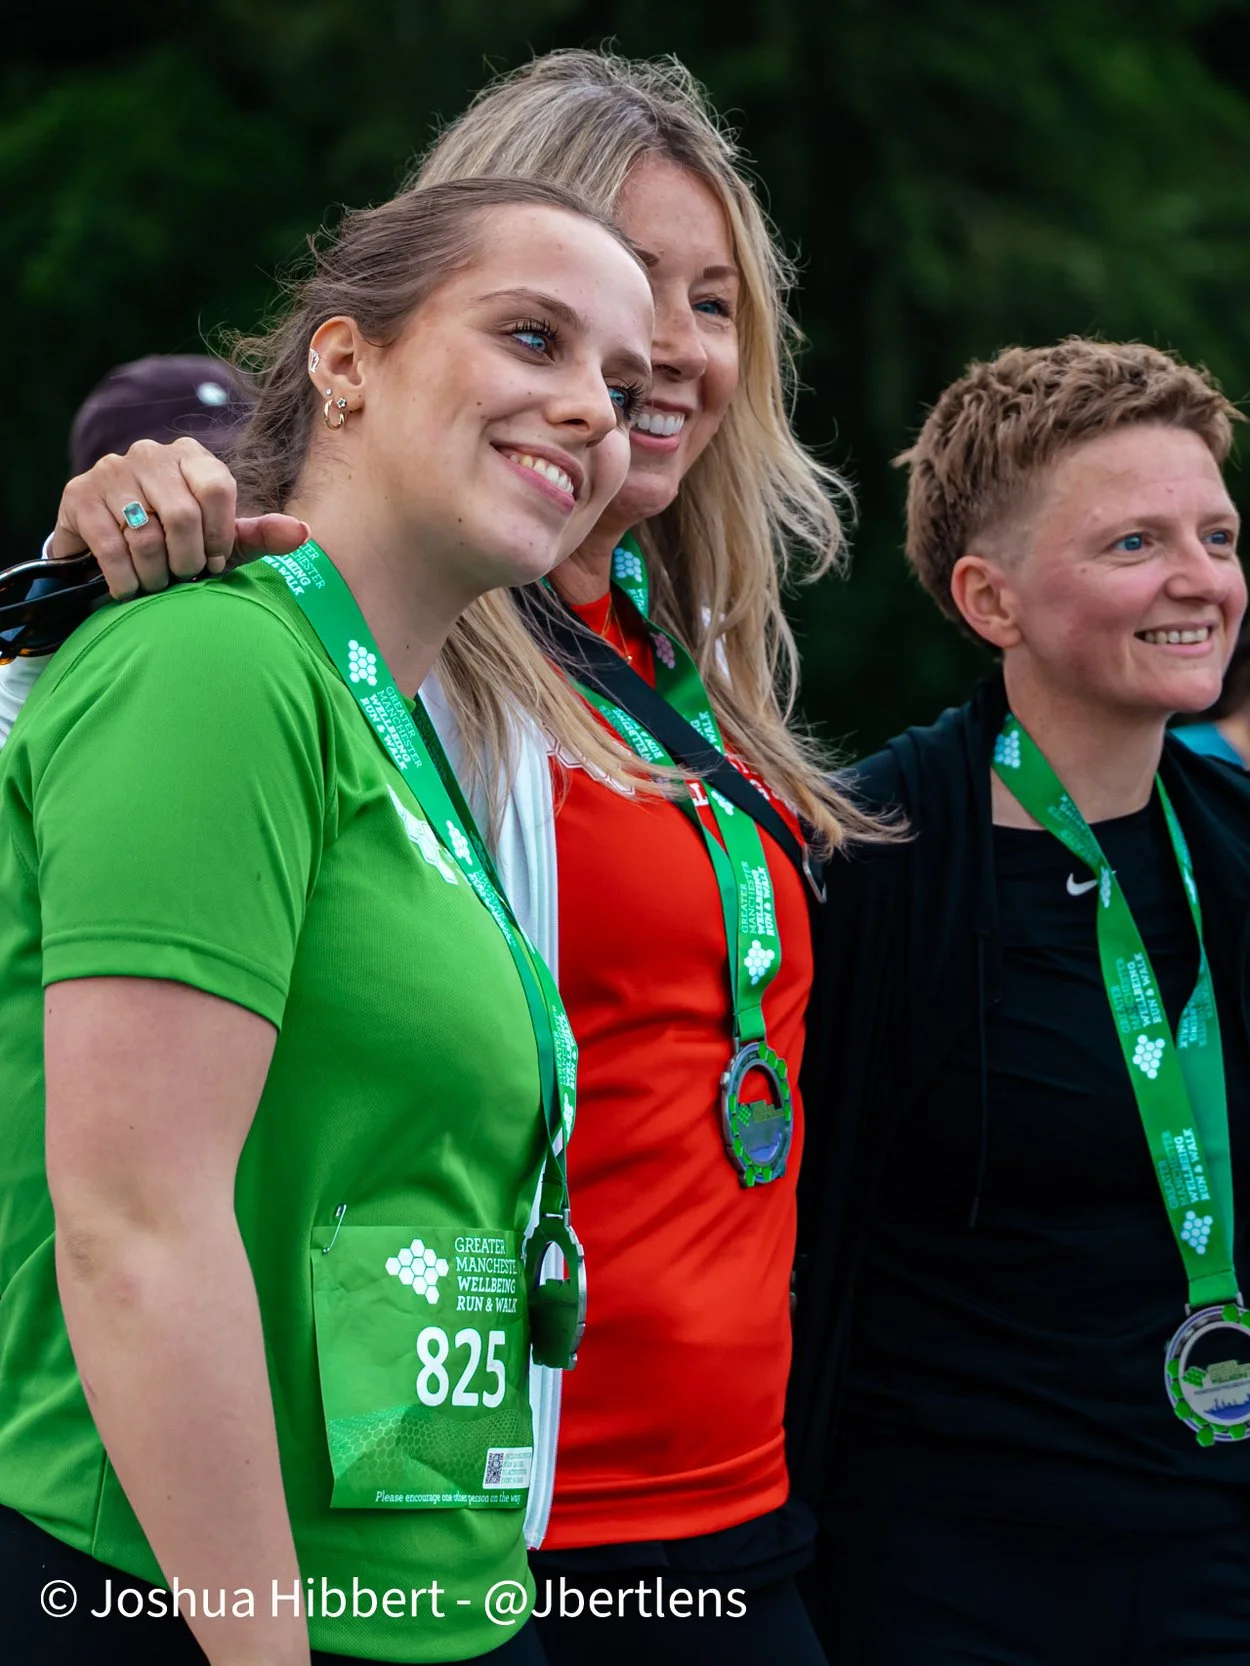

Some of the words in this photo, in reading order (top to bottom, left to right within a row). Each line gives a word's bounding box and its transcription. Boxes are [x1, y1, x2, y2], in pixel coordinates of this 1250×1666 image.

[278, 566, 305, 596] WALK
[290, 549, 325, 589] HESTER
[369, 693, 411, 762] WELLBEING
[377, 690, 423, 768] MANCHESTER
[386, 686, 416, 737] GREATER
[360, 697, 380, 722] RUN
[384, 735, 408, 770] WALK
[741, 861, 757, 935] MANCHESTER
[1133, 952, 1150, 986] WALK
[1127, 961, 1151, 1028] WELLBEING
[1147, 999, 1162, 1024] RUN
[1183, 1127, 1199, 1163] WALK
[1174, 1136, 1199, 1203] WELLBEING
[1195, 1175, 1211, 1200] RUN
[454, 1237, 506, 1255] GREATER
[455, 1256, 518, 1275] MANCHESTE
[457, 1275, 517, 1294] WELLBEING
[456, 1295, 484, 1312] RUN
[485, 1297, 494, 1313] &
[495, 1297, 518, 1313] WALK
[416, 1325, 506, 1408] 825
[375, 1490, 404, 1503] Please
[405, 1493, 441, 1505] encourage
[490, 1495, 498, 1503] on
[499, 1491, 509, 1503] the
